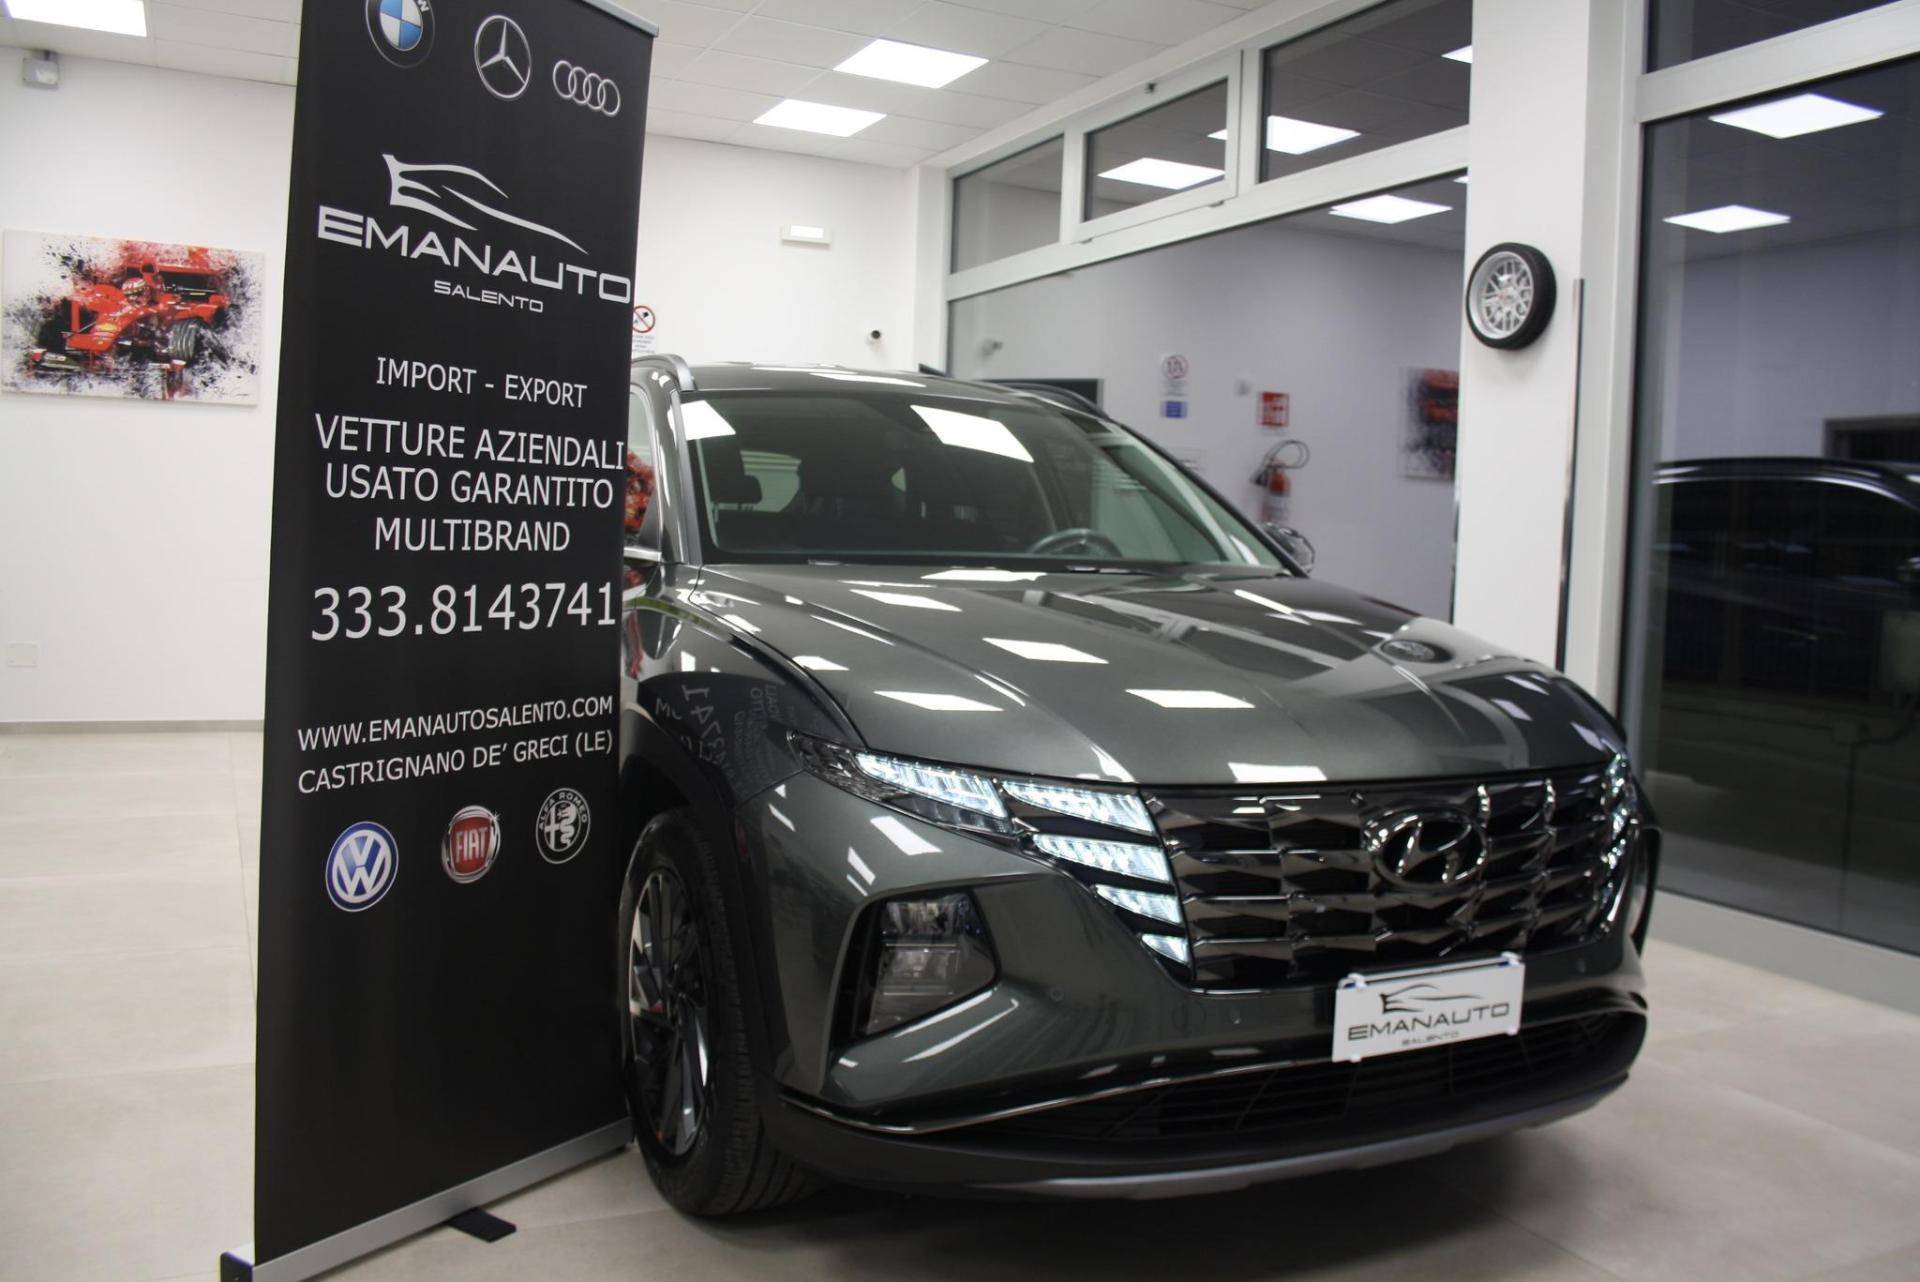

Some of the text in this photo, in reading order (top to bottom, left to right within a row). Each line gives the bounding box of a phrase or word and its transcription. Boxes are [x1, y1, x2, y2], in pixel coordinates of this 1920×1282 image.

[318, 205, 631, 304] EMANAUTO
[433, 279, 544, 313] SALENTO
[376, 357, 477, 395] IMPORT
[504, 374, 588, 409] EXPORT
[315, 412, 624, 470] VETTURE AZIENDALI
[325, 462, 614, 509] USATO GARANTITO
[374, 517, 571, 552] MULTIBRAND
[311, 582, 616, 642] 333.8143741
[297, 695, 614, 752] WWW.EMANAUTOSALENTO.COM
[298, 749, 465, 794] CASTRIGNANO
[513, 734, 569, 763] GRECI
[575, 729, 614, 758] (LE)
[559, 792, 588, 823] ROMEO
[454, 826, 490, 864] FIAT
[1348, 1002, 1510, 1041] EMANAUTO
[1402, 1030, 1460, 1046] SALENTO
